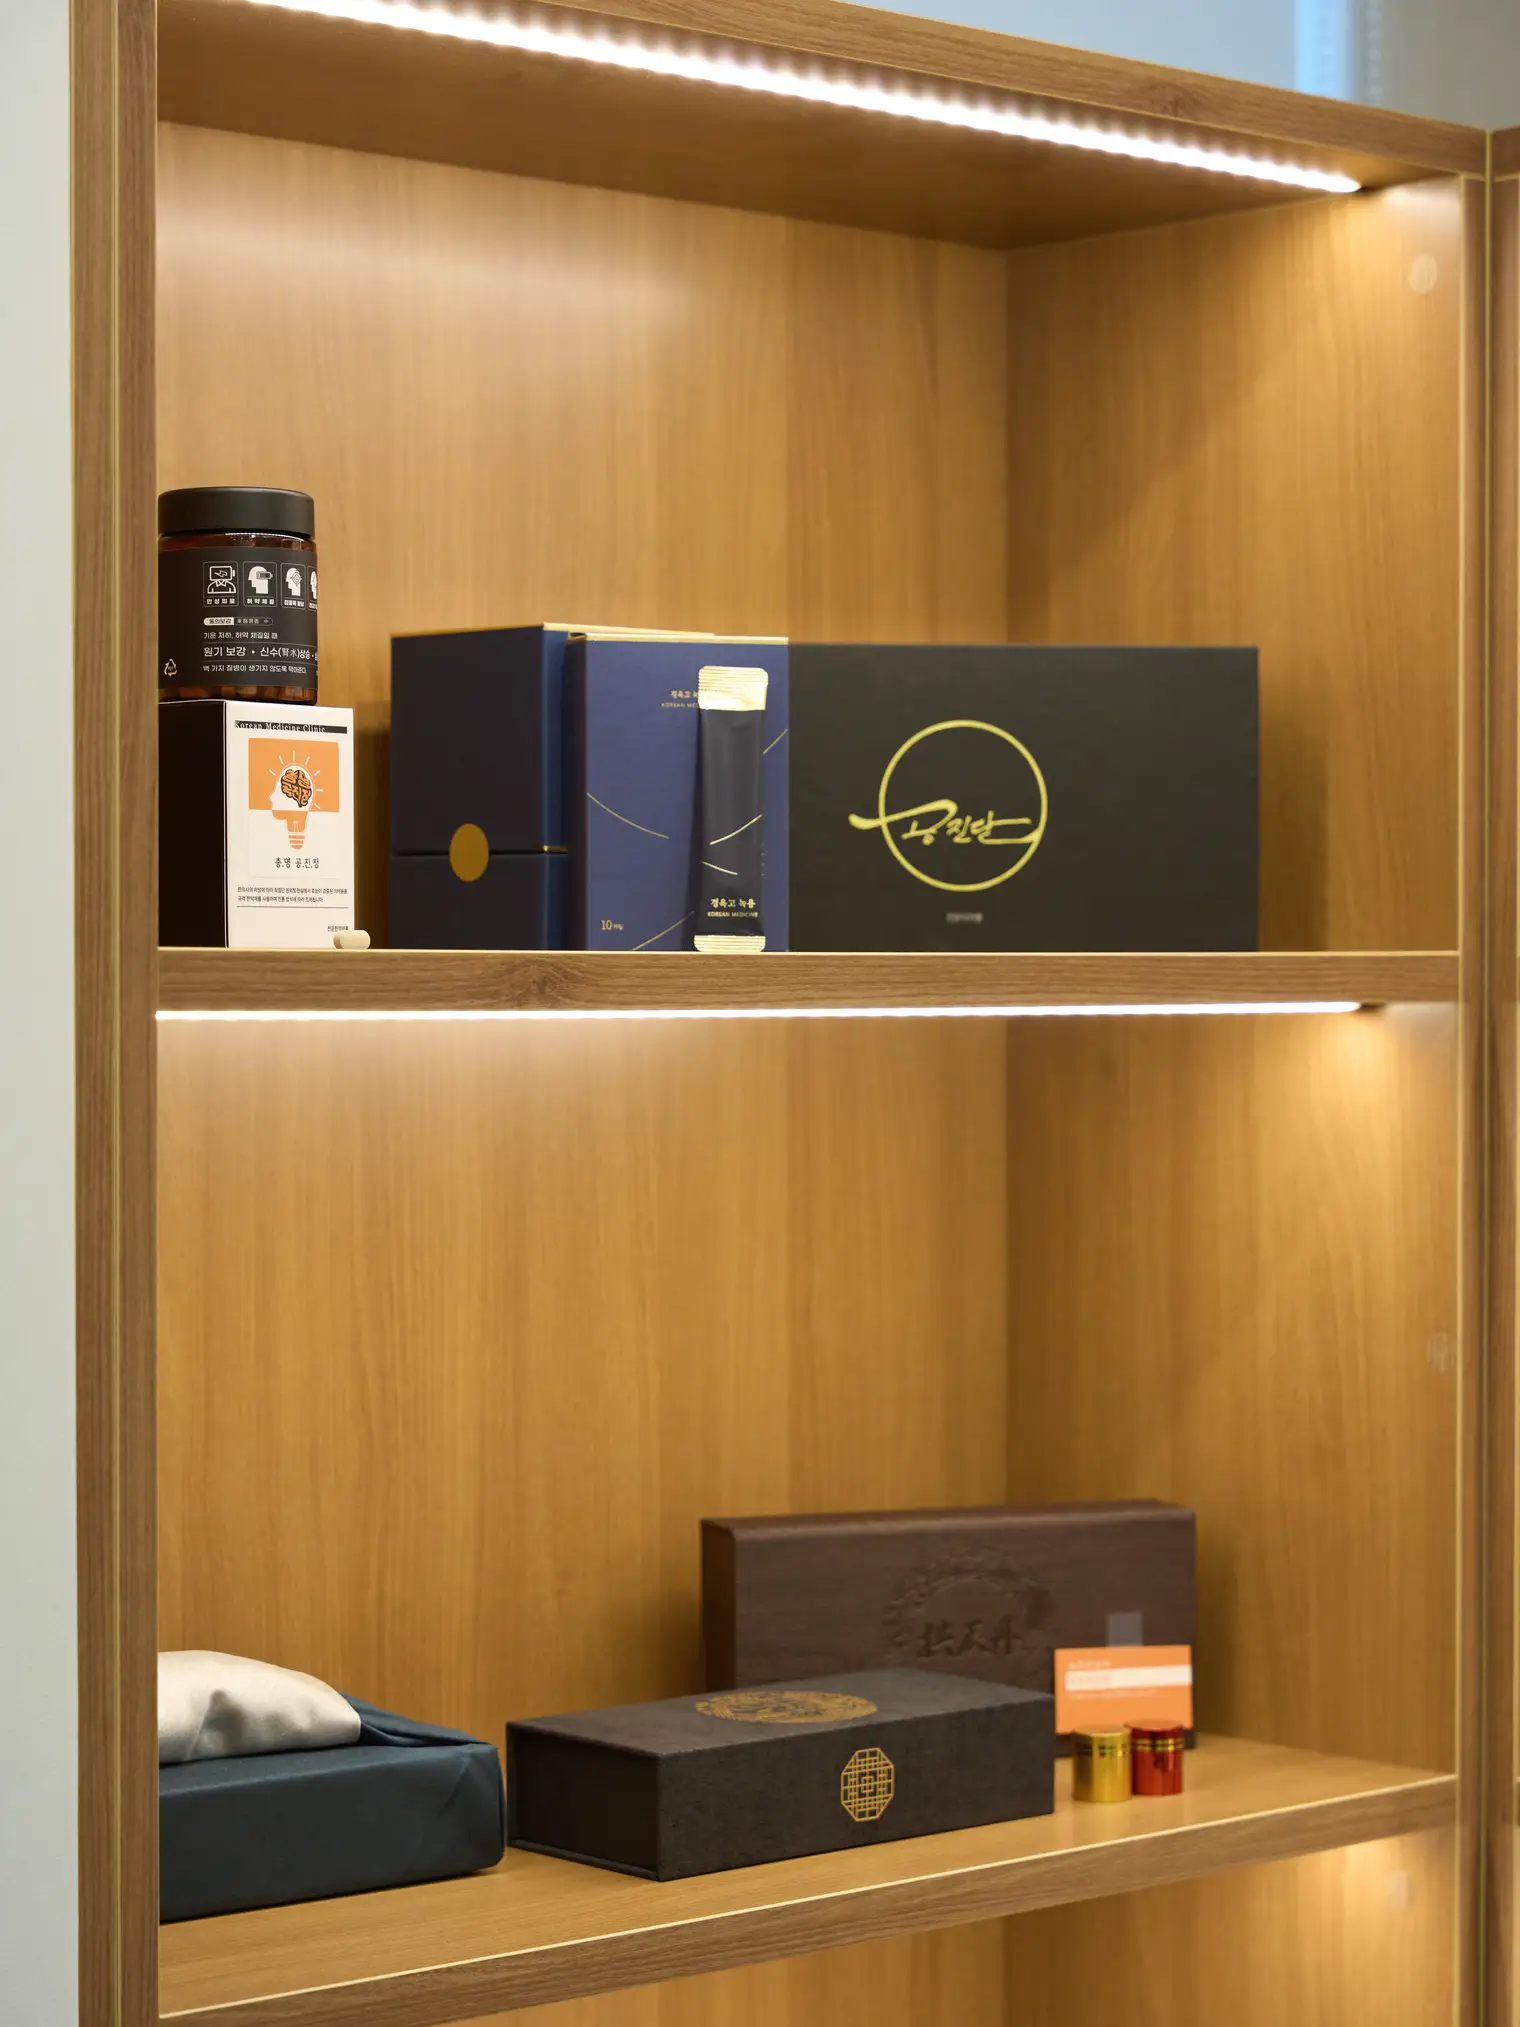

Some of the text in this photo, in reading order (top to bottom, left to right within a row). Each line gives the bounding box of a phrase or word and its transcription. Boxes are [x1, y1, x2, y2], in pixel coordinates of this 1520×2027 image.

[203, 646, 223, 657] 원기
[226, 646, 246, 657] 보강
[234, 720, 326, 733] Korean Medicine Clinic
[710, 898, 756, 909] 경옥고 녹용
